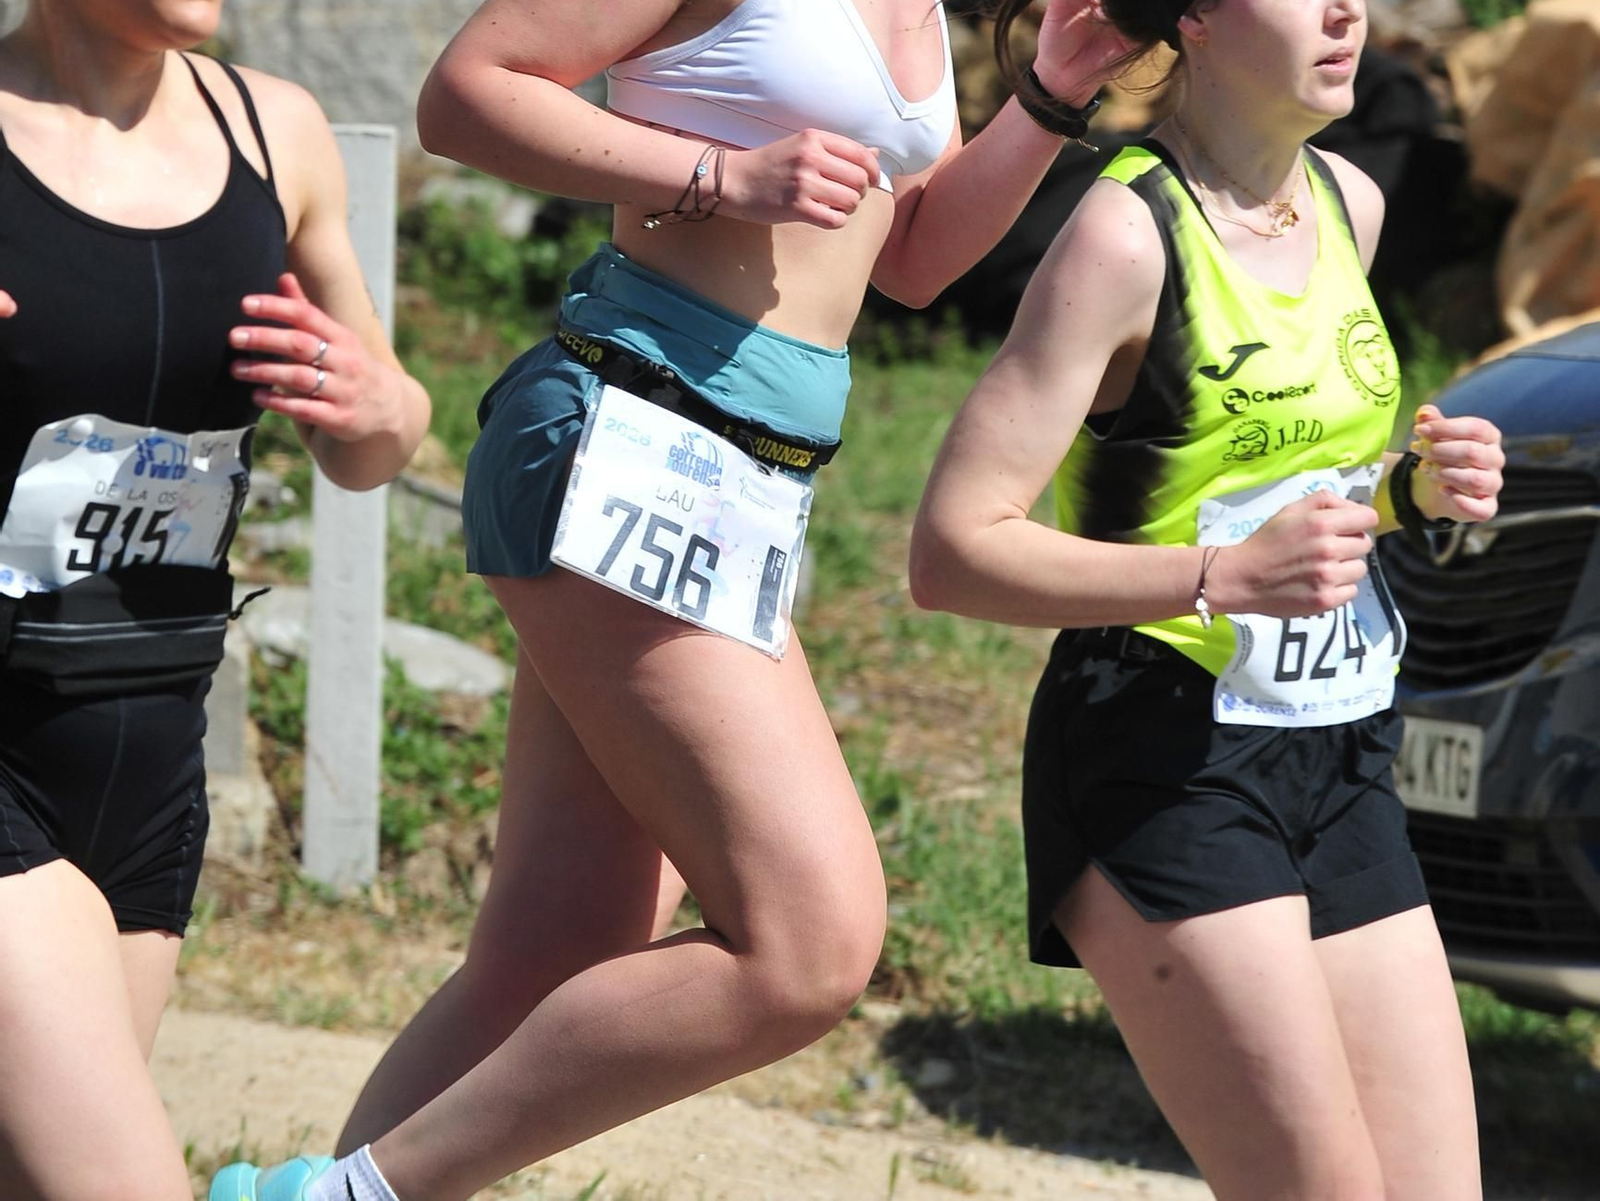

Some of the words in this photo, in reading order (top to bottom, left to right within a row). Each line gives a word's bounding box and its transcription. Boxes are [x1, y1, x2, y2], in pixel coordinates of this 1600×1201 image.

[655, 484, 695, 512] LAU
[66, 502, 177, 571] 915
[594, 493, 720, 621] 756
[1274, 602, 1367, 682] 624
[1423, 732, 1471, 801] KTG
